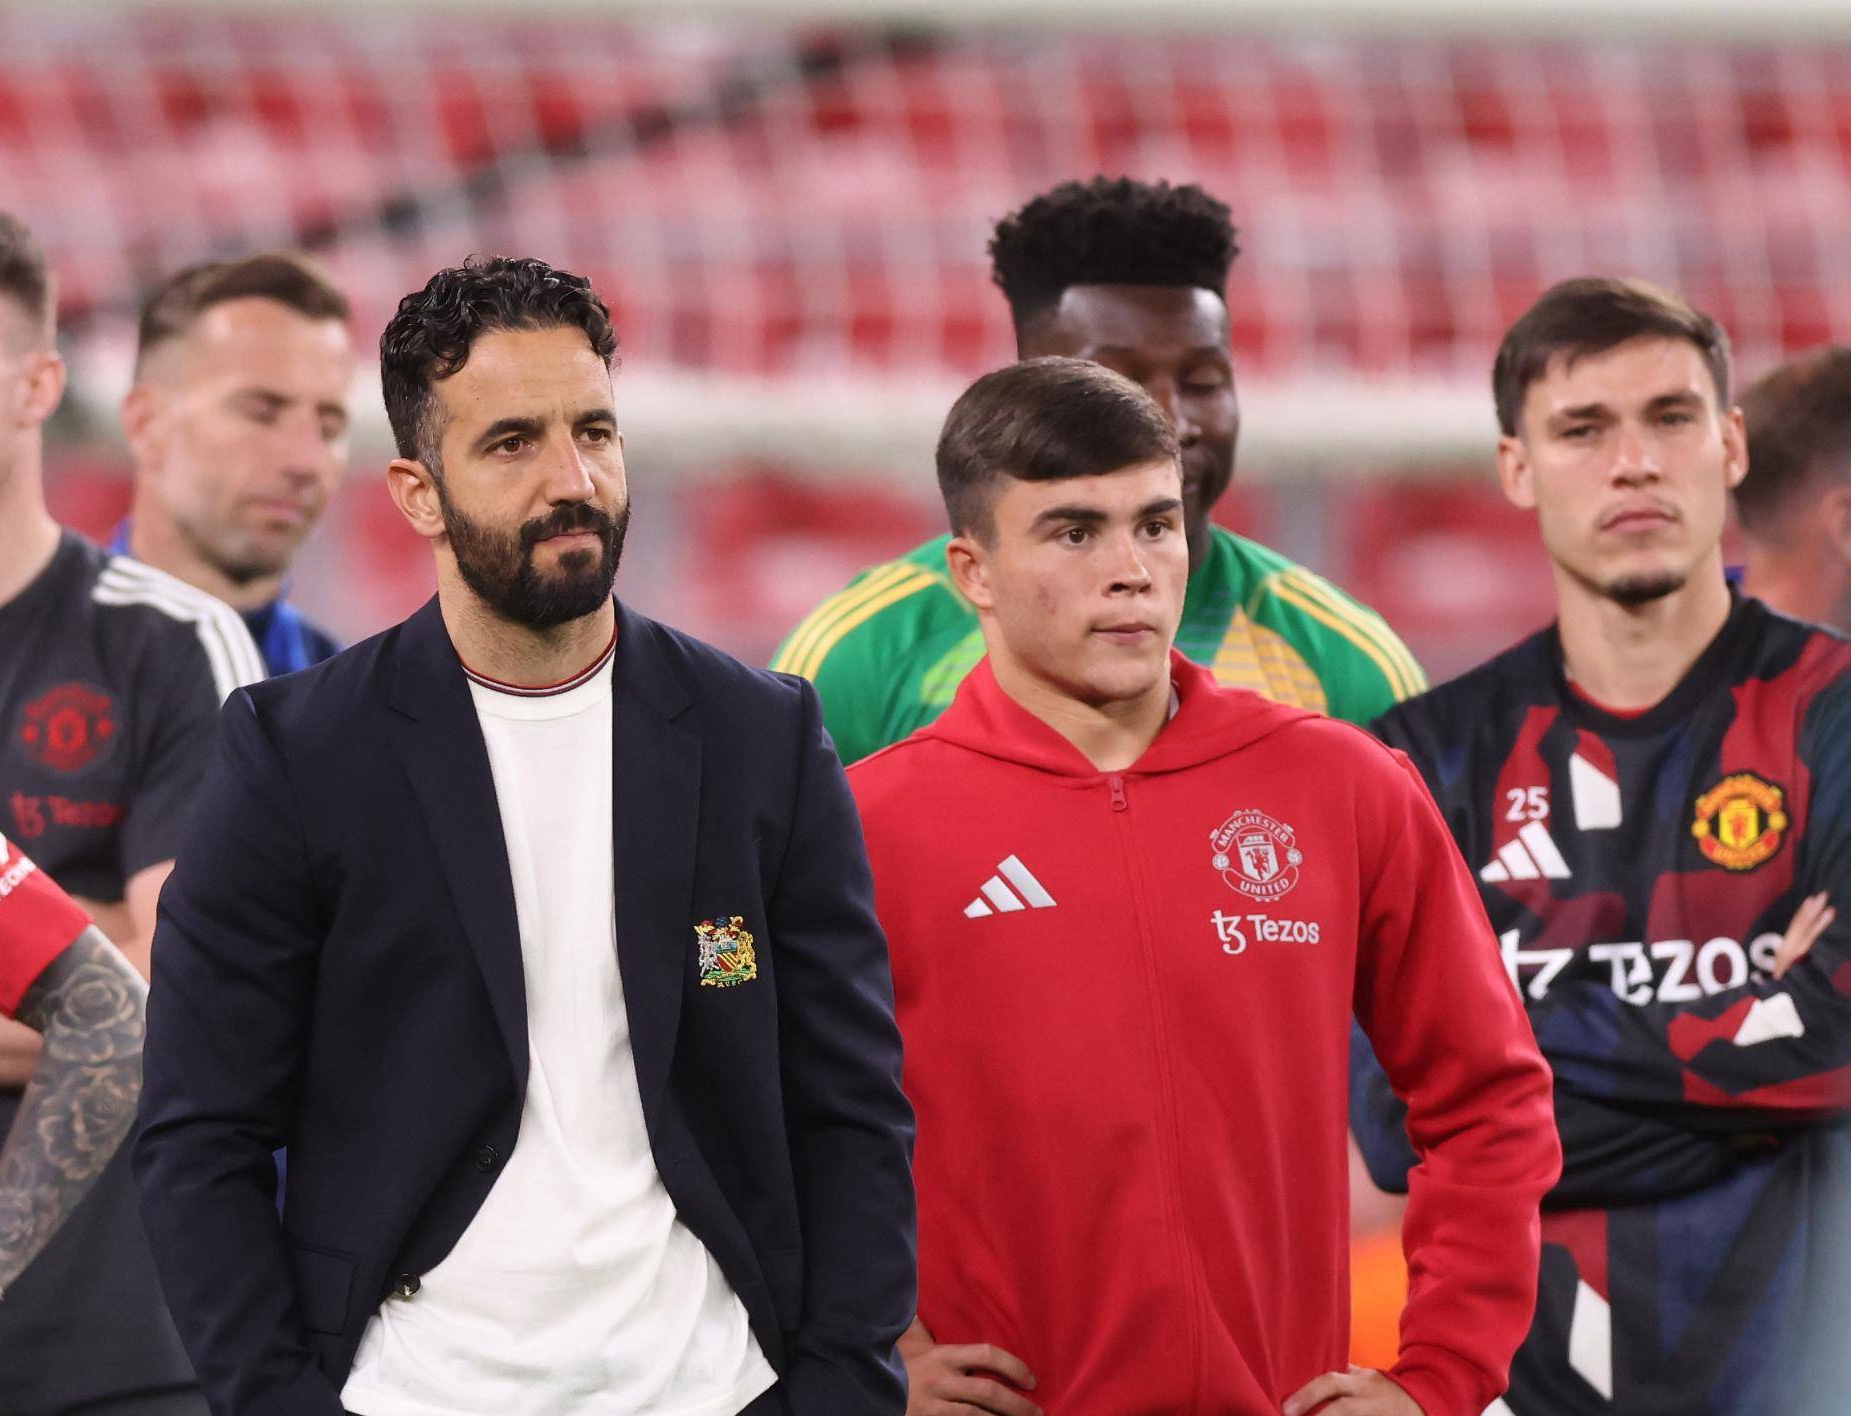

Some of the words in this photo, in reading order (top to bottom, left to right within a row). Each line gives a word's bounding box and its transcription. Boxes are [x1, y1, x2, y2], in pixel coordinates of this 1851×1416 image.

[1505, 785, 1550, 822] 25
[1218, 815, 1290, 847] MANCHESTER
[1239, 877, 1290, 895] UNITED
[1247, 914, 1320, 945] Tezos
